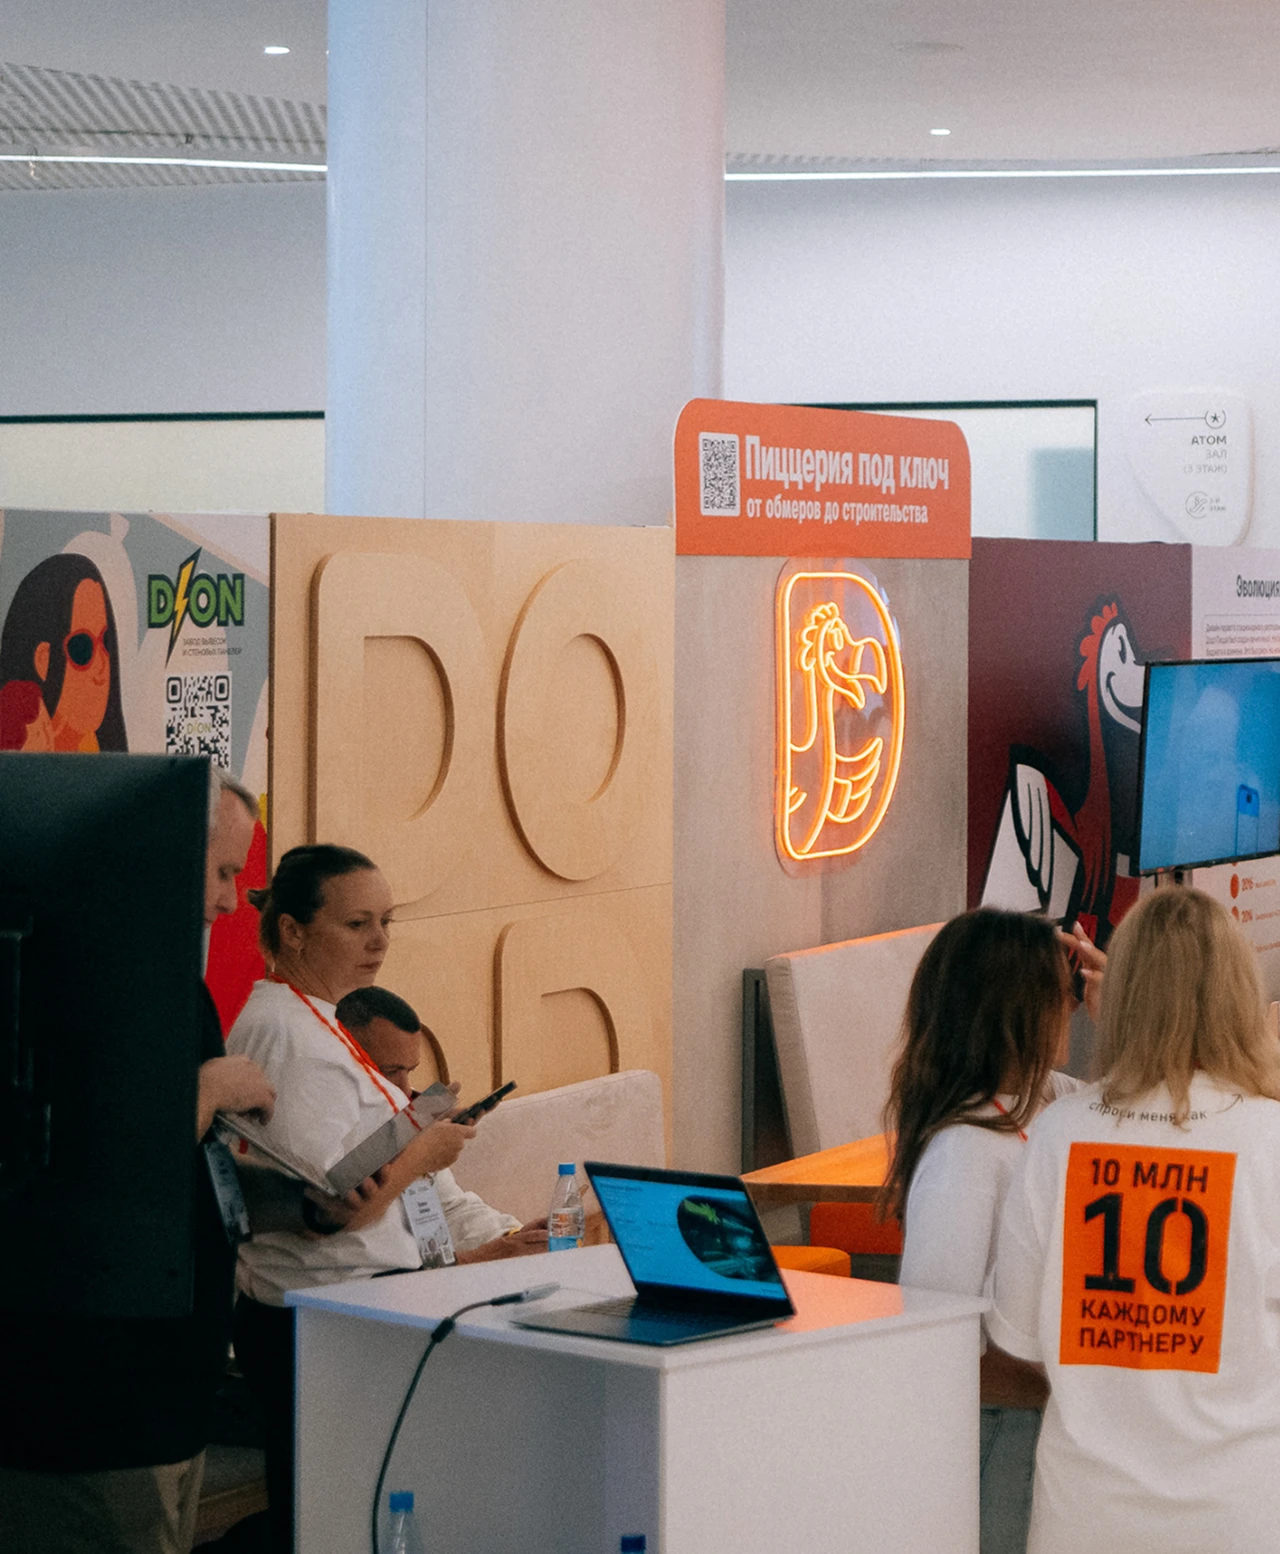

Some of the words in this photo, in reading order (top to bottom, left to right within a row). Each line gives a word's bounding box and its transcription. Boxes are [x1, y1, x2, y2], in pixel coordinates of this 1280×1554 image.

[1191, 434, 1228, 446] АТОМ
[745, 434, 854, 493] Пиццерия
[858, 453, 896, 495] под
[899, 456, 950, 491] ключ
[1206, 448, 1228, 460] ЗАЛ
[746, 497, 763, 519] от
[765, 494, 821, 524] обмеров
[823, 502, 839, 524] до
[842, 502, 929, 526] строительства
[1236, 573, 1280, 598] Эволюция
[1088, 1100, 1135, 1120] спроси
[1139, 1110, 1178, 1123] меня
[1092, 1157, 1121, 1186] 10
[1133, 1161, 1208, 1193] МЛН
[1084, 1192, 1210, 1296] 10
[1081, 1299, 1206, 1327] КАЖДОМУ
[1079, 1327, 1204, 1354] ПАРТНЕРУ
